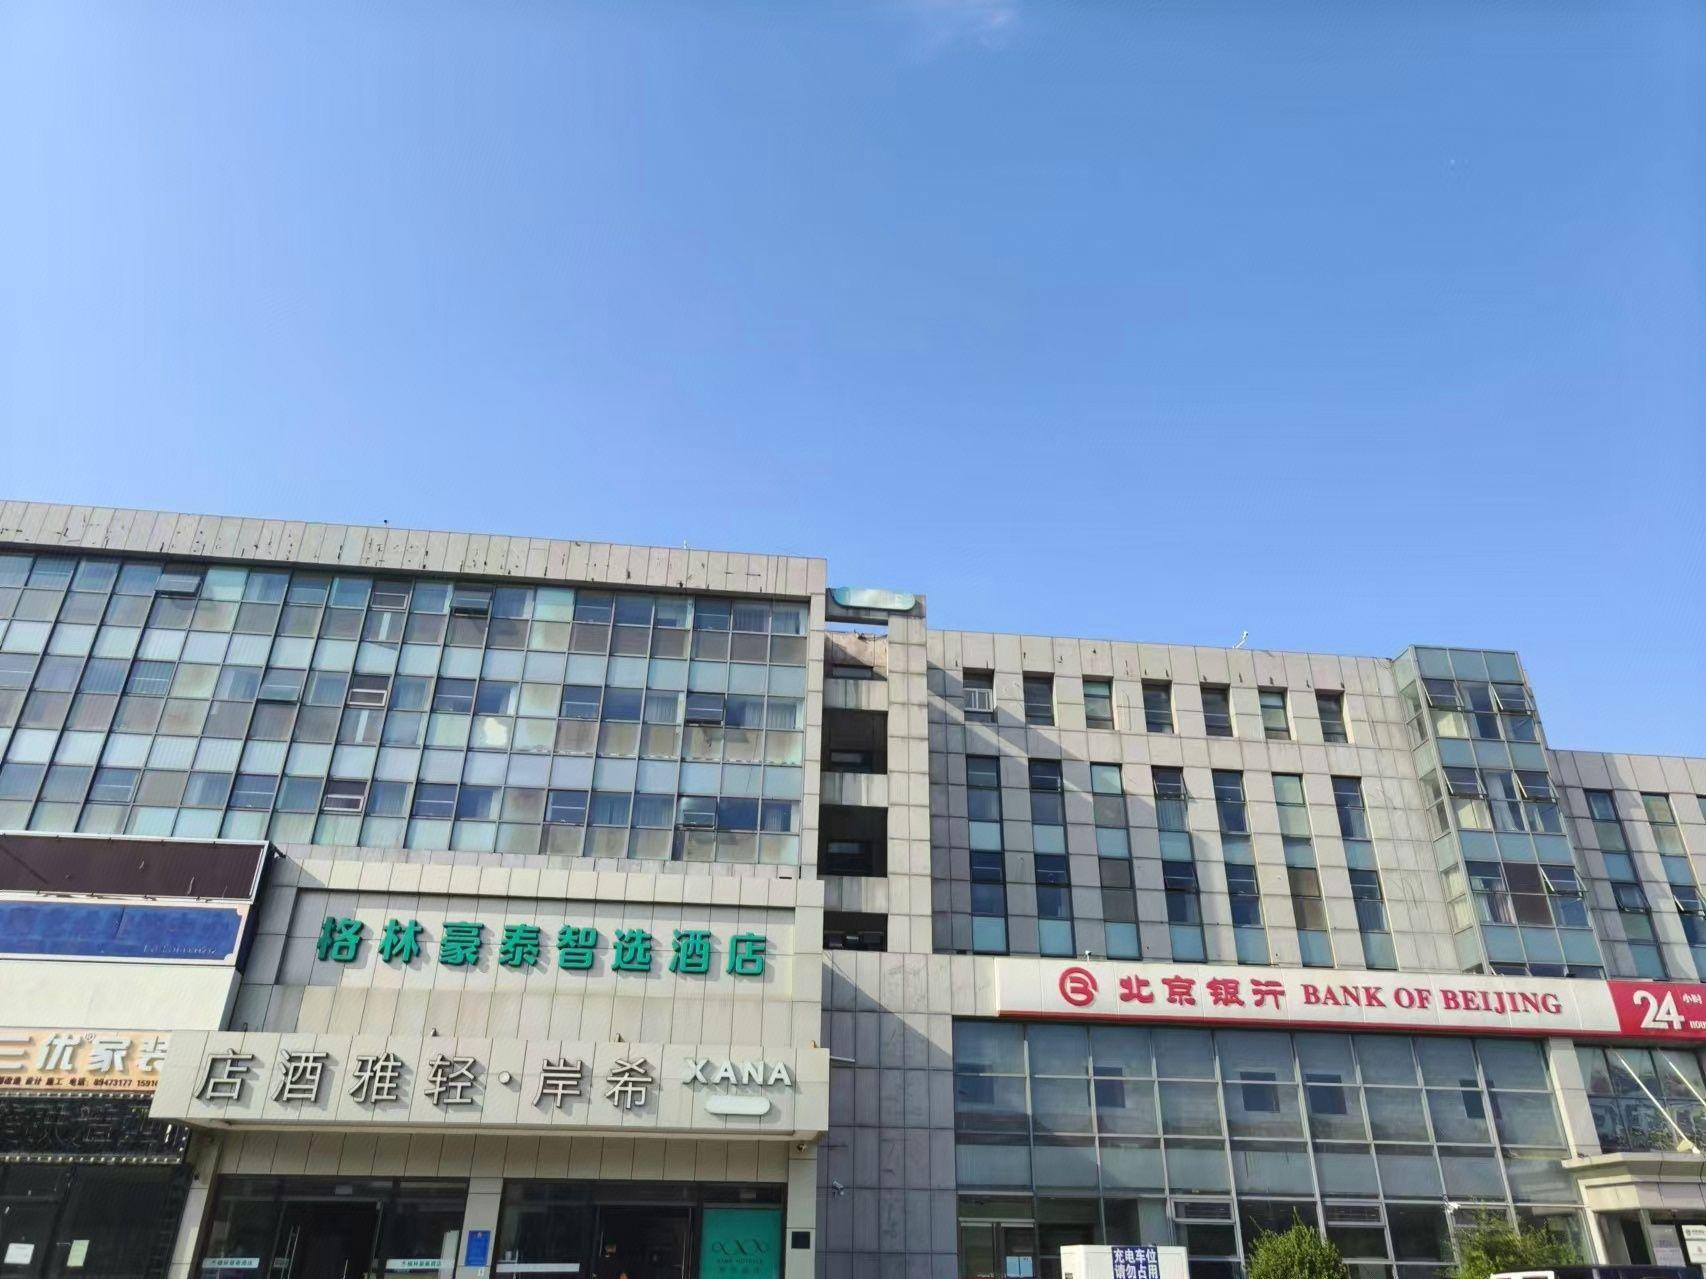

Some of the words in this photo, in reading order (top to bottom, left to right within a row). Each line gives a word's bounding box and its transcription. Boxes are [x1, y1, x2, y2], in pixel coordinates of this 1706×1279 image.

[317, 916, 767, 977] 格林豪泰智选酒店
[1119, 974, 1286, 1010] 北京银行
[1301, 984, 1387, 1008] BANK
[1393, 987, 1432, 1010] OF
[1440, 989, 1562, 1015] BEIJING
[1632, 989, 1685, 1030] 24
[682, 1057, 793, 1086] XANA
[1113, 1248, 1158, 1264] 充电车位
[1114, 1264, 1159, 1279] 请勿占用
